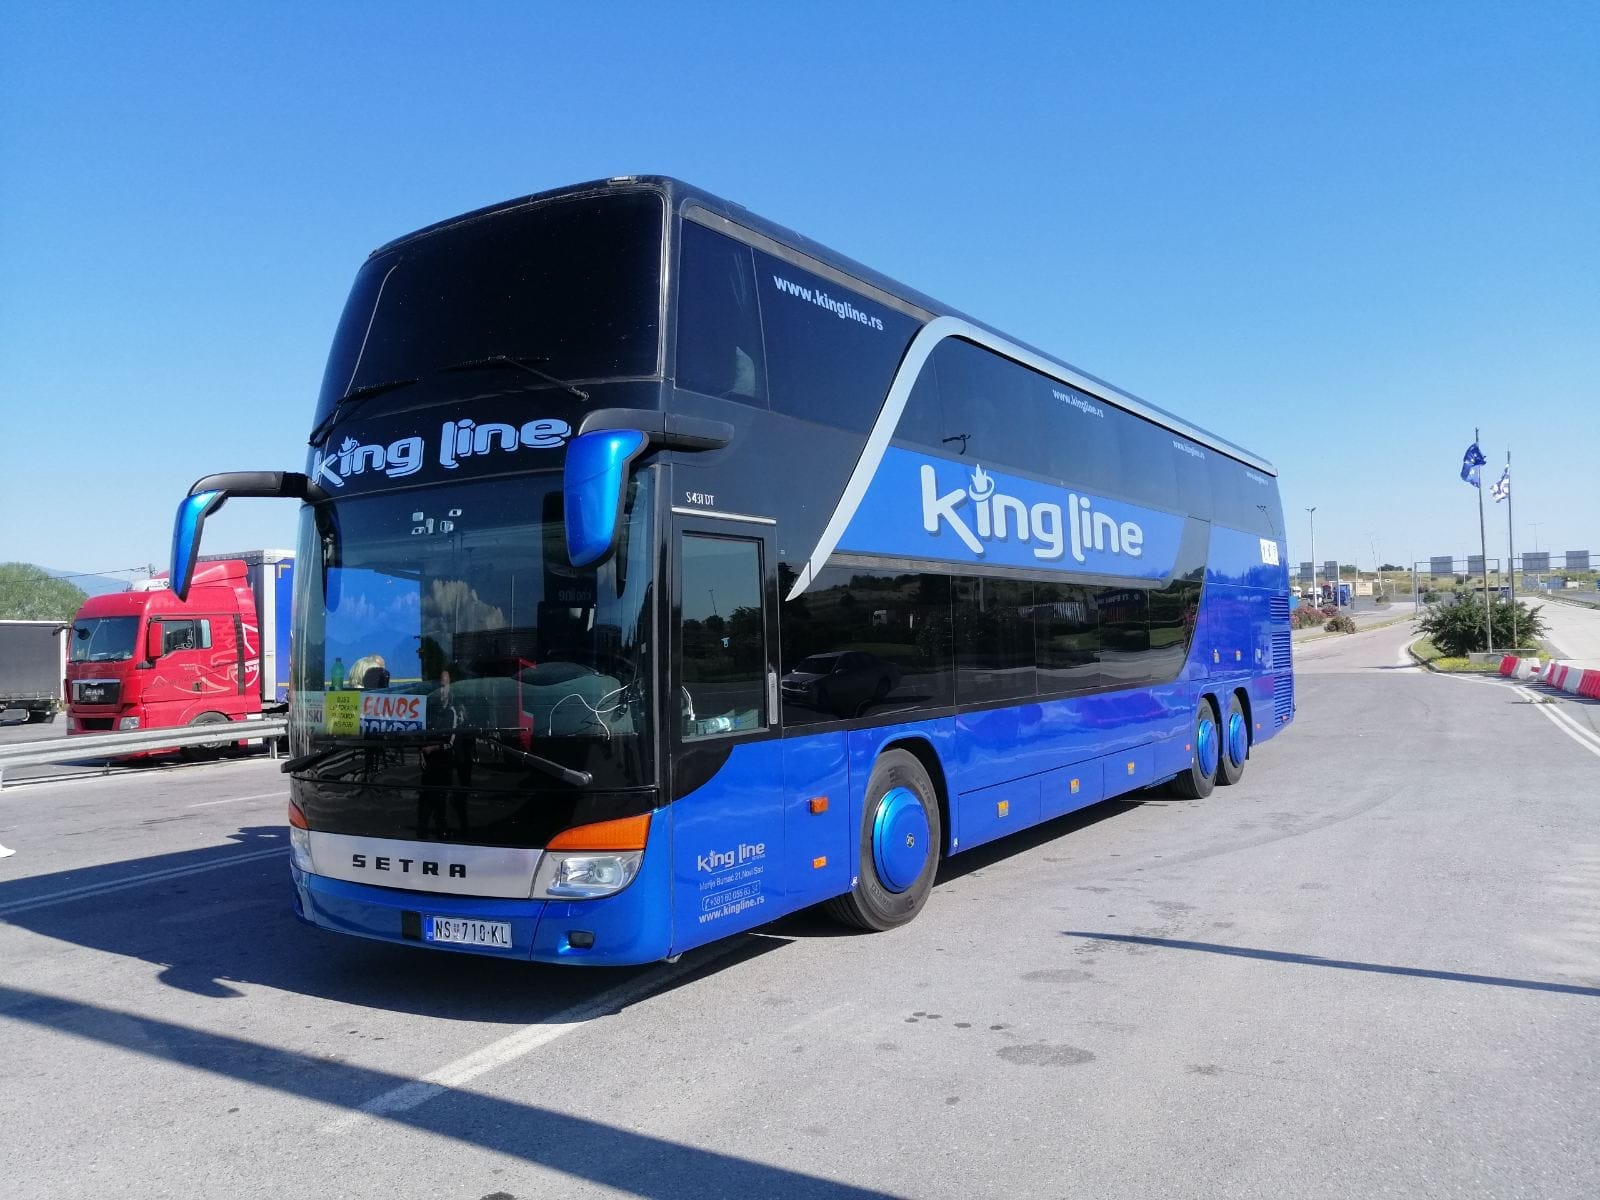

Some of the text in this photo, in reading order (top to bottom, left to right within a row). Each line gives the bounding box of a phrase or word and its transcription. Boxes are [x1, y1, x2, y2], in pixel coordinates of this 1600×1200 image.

[773, 275, 884, 331] www.kingline.rs
[312, 418, 572, 488] king line
[920, 464, 1144, 564] king line
[352, 854, 466, 878] SETRA
[697, 843, 766, 872] king line
[699, 895, 765, 923] www.kingline.rs
[435, 920, 451, 938] NS
